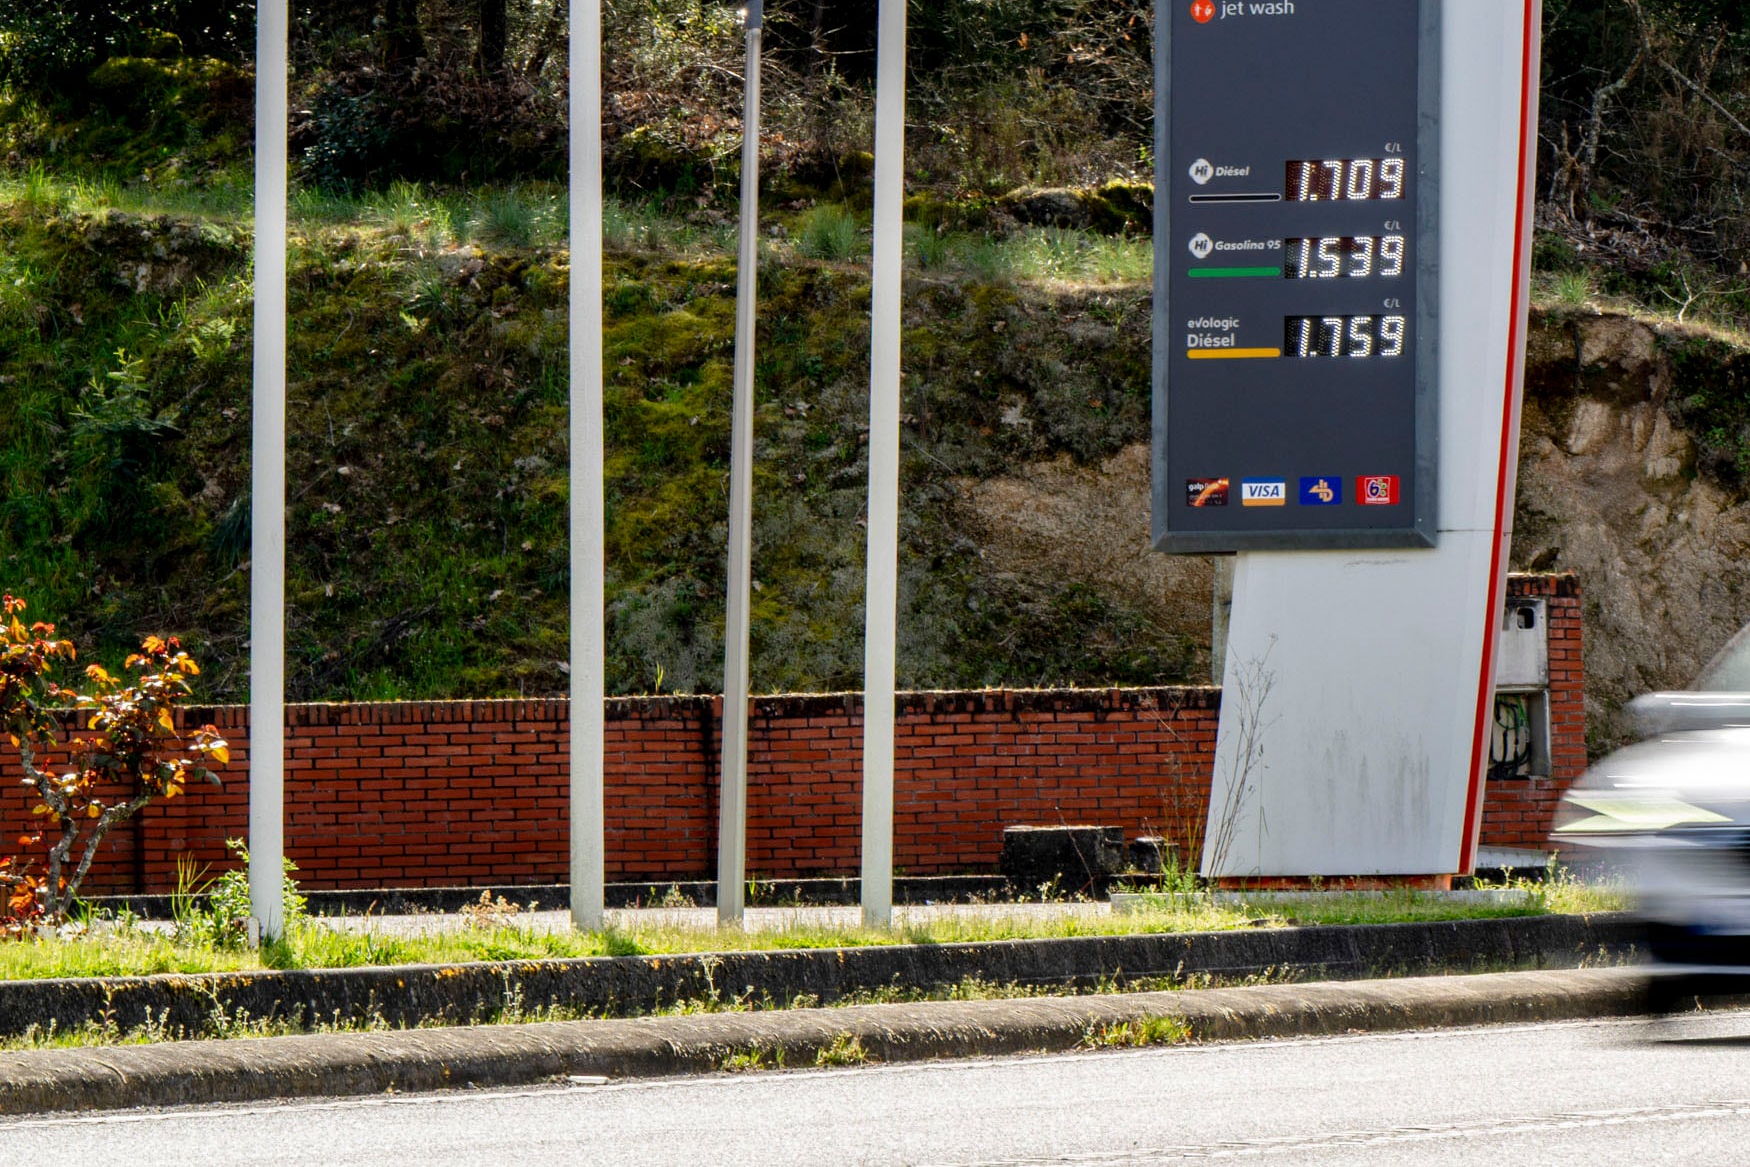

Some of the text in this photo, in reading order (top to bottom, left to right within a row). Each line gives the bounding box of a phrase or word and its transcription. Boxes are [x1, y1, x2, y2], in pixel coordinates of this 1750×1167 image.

[1220, 0, 1244, 20] jet
[1194, 165, 1250, 177] Hi Diésel
[1299, 158, 1405, 202] 1.709
[1194, 239, 1282, 251] Hi Gasolina 95
[1299, 235, 1405, 279] 1.539
[1187, 333, 1235, 348] Diésel
[1299, 316, 1405, 358] 1.759
[1249, 485, 1280, 498] VISA
